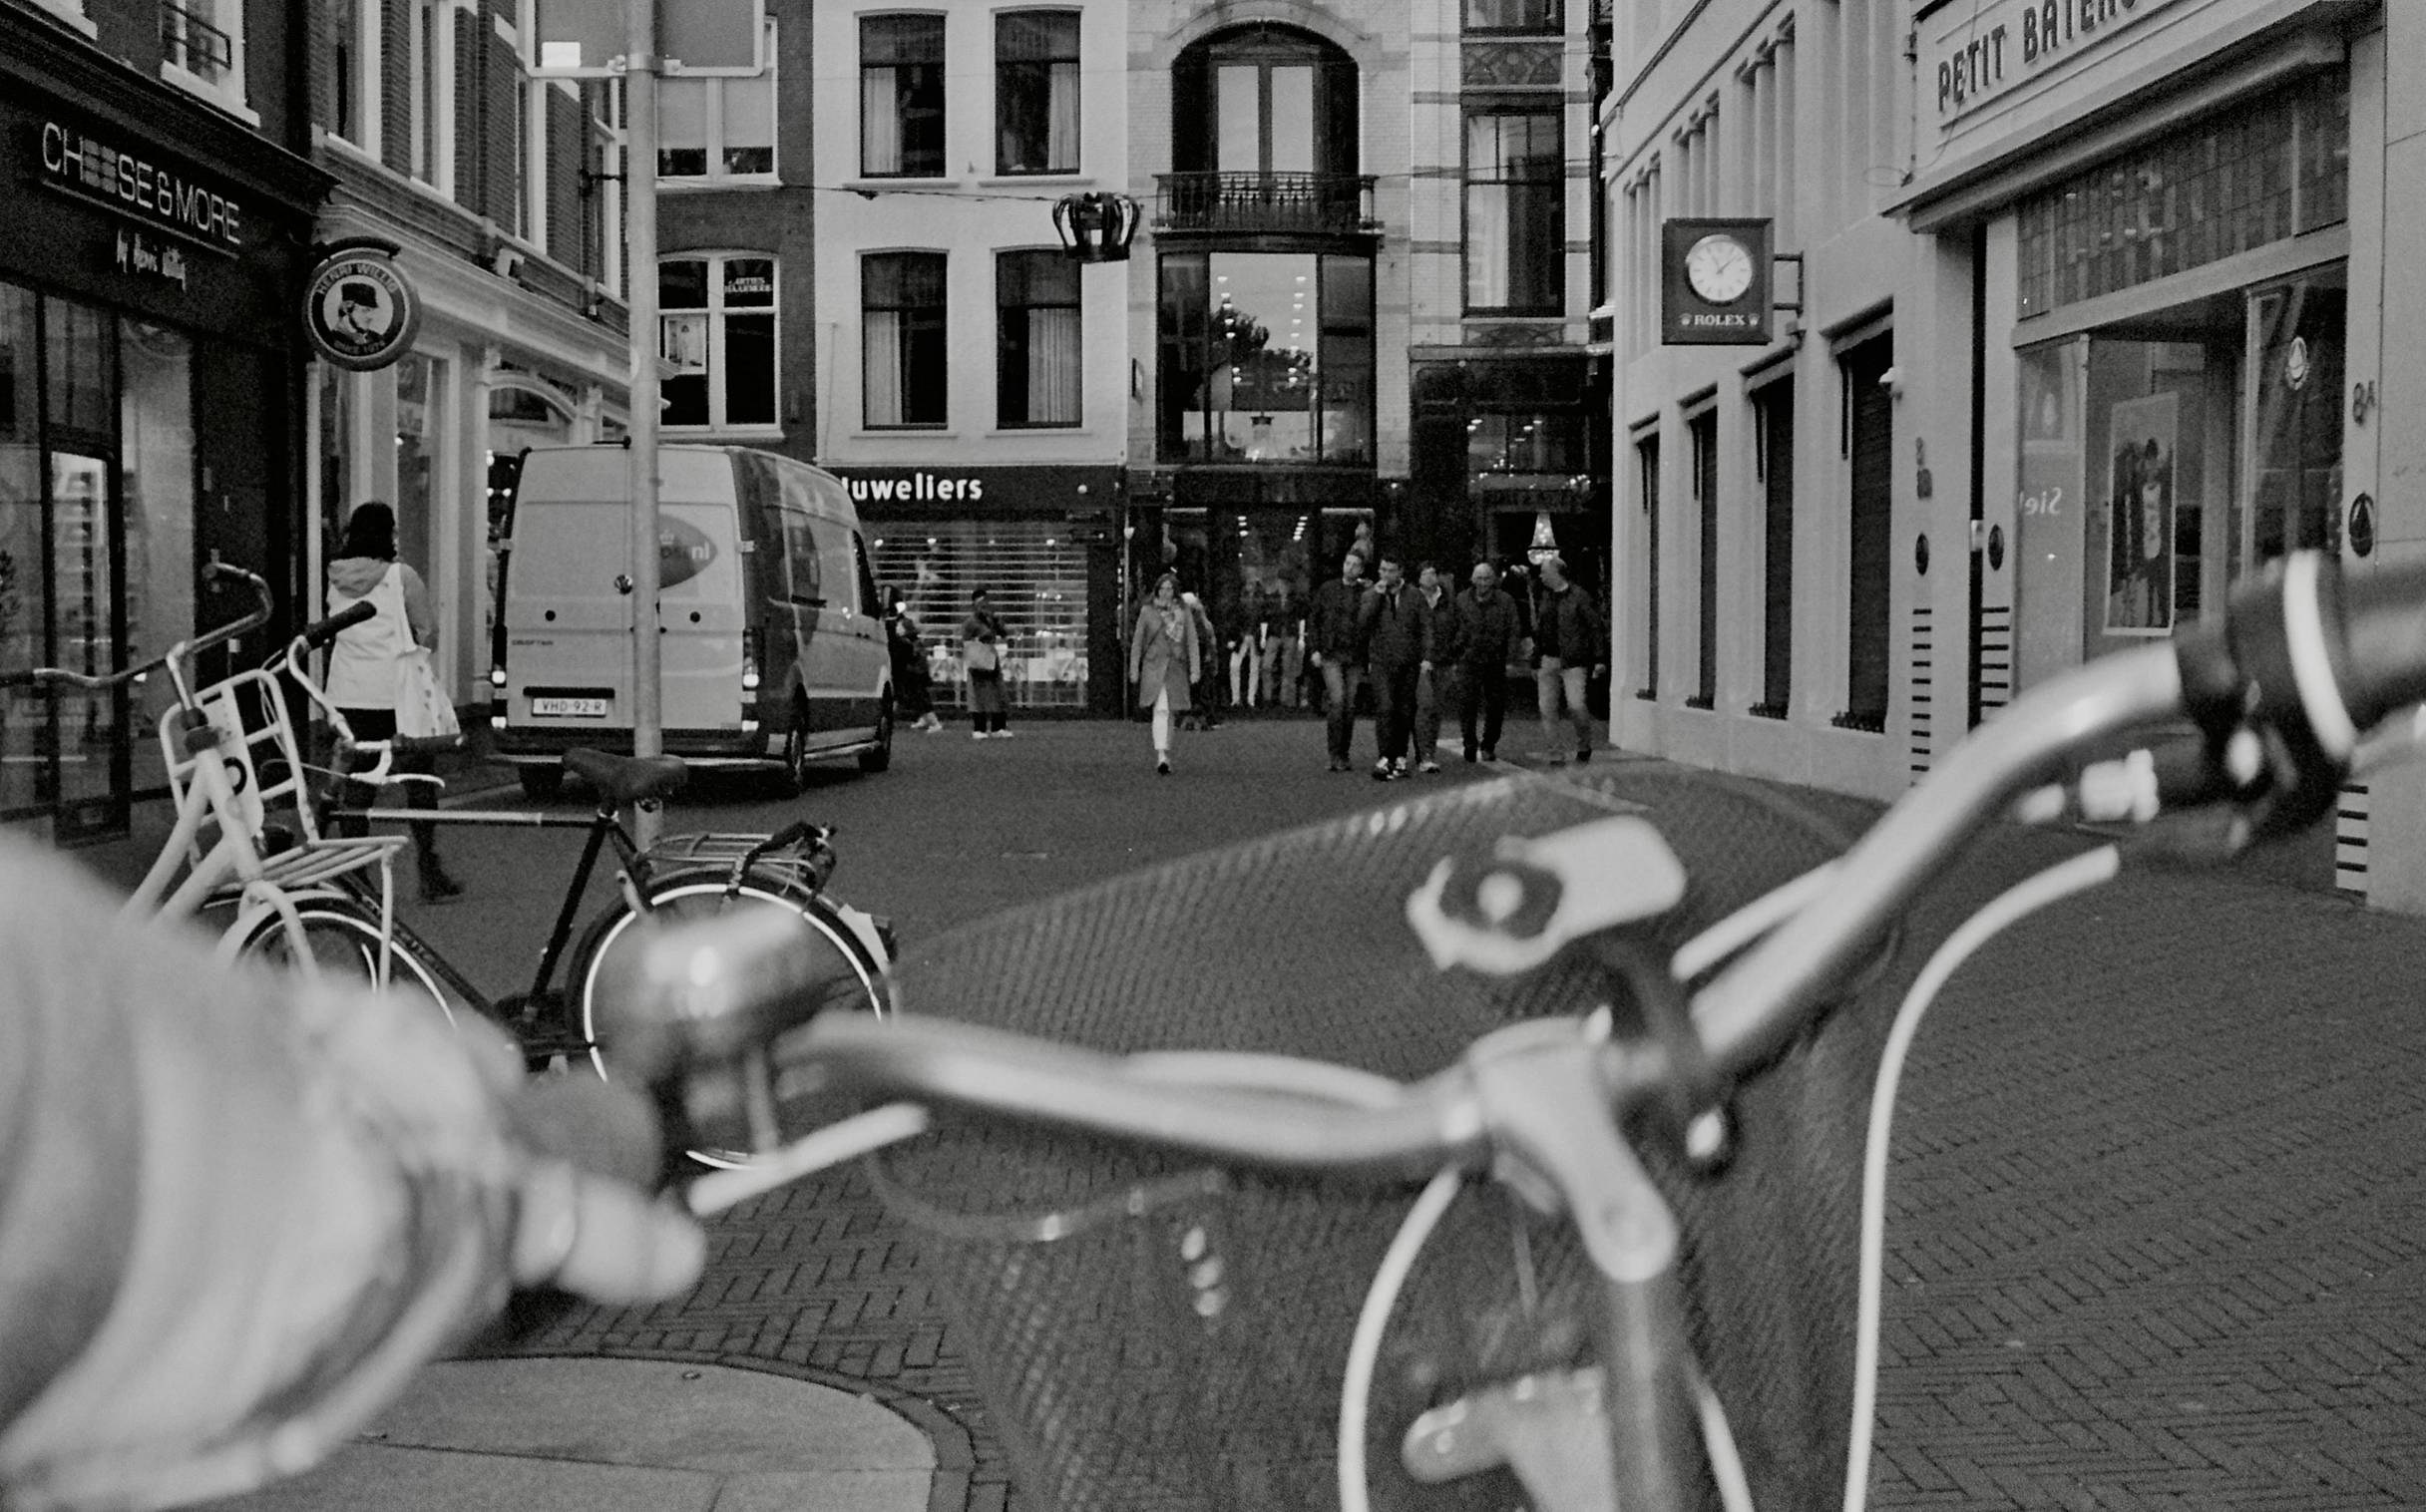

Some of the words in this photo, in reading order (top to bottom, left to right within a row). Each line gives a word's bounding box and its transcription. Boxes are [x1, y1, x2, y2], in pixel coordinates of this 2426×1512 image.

[1938, 24, 2005, 112] PETIT
[2023, 0, 2136, 64] BATE
[158, 171, 173, 215] &
[176, 179, 240, 244] MORE
[1694, 314, 1746, 327] ROLEX
